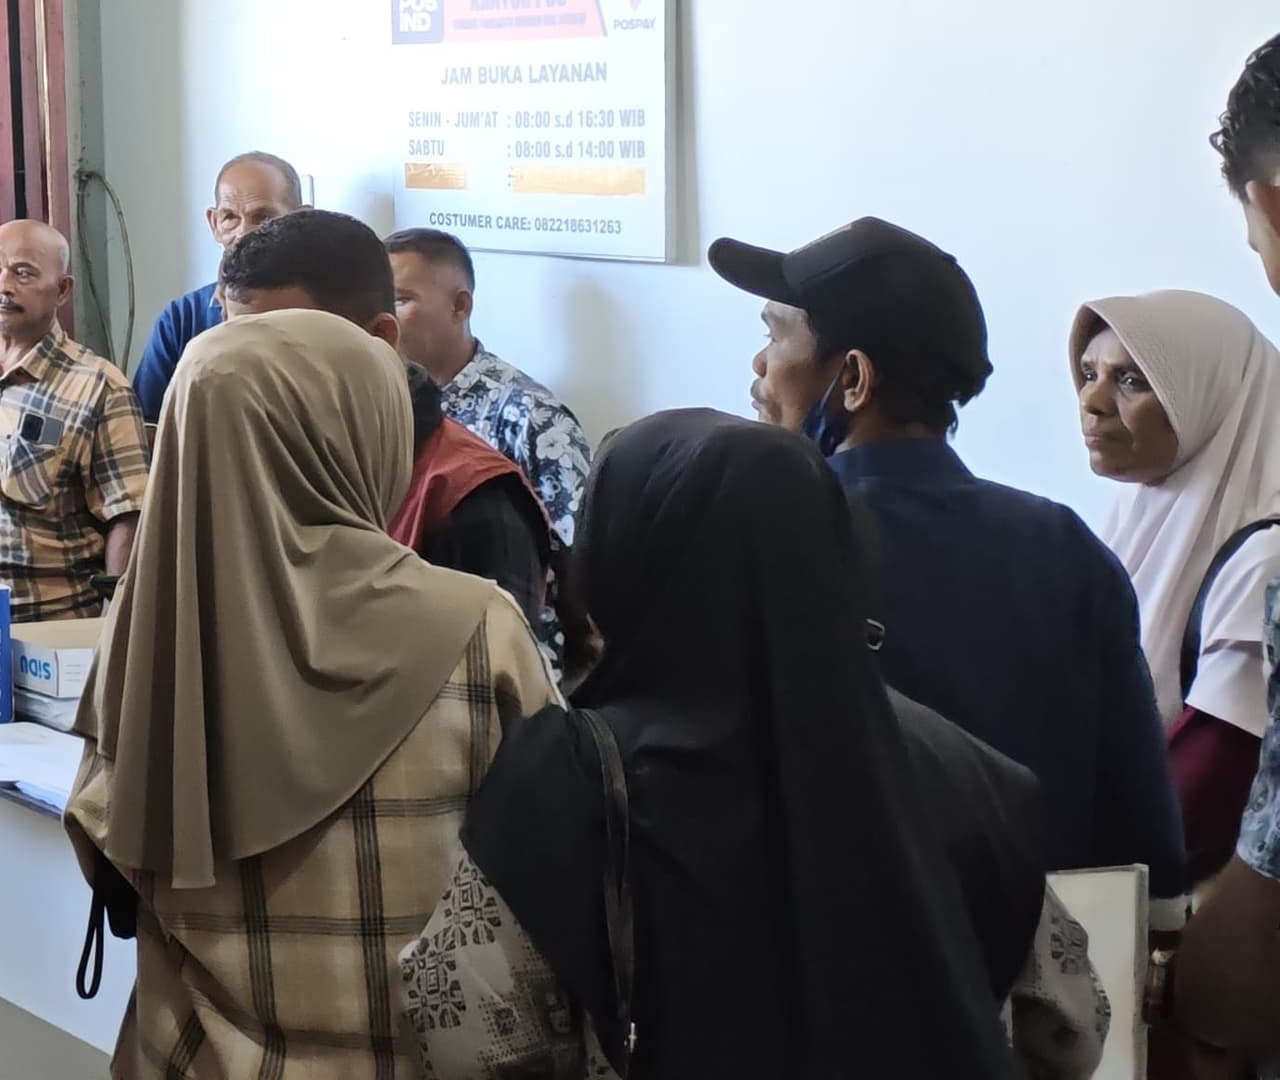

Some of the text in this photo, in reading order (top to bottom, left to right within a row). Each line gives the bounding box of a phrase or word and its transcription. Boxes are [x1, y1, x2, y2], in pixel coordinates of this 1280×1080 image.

[399, 12, 432, 33] IND
[613, 16, 656, 30] POSPAY
[440, 61, 608, 85] JAM BUKA LAYANAN
[408, 111, 442, 128] SENIN
[454, 111, 498, 129] JUM'AT
[515, 110, 551, 129] 08:00
[554, 109, 574, 129] s.d
[577, 109, 615, 128] 16:30
[619, 107, 646, 128] WIB
[408, 139, 445, 157] SABTU
[515, 140, 551, 159] 08:00
[554, 139, 574, 159] s.d
[577, 140, 615, 159] 14:00
[619, 140, 646, 159] WIB
[429, 212, 493, 229] COSTUMER
[495, 216, 531, 231] CARE:
